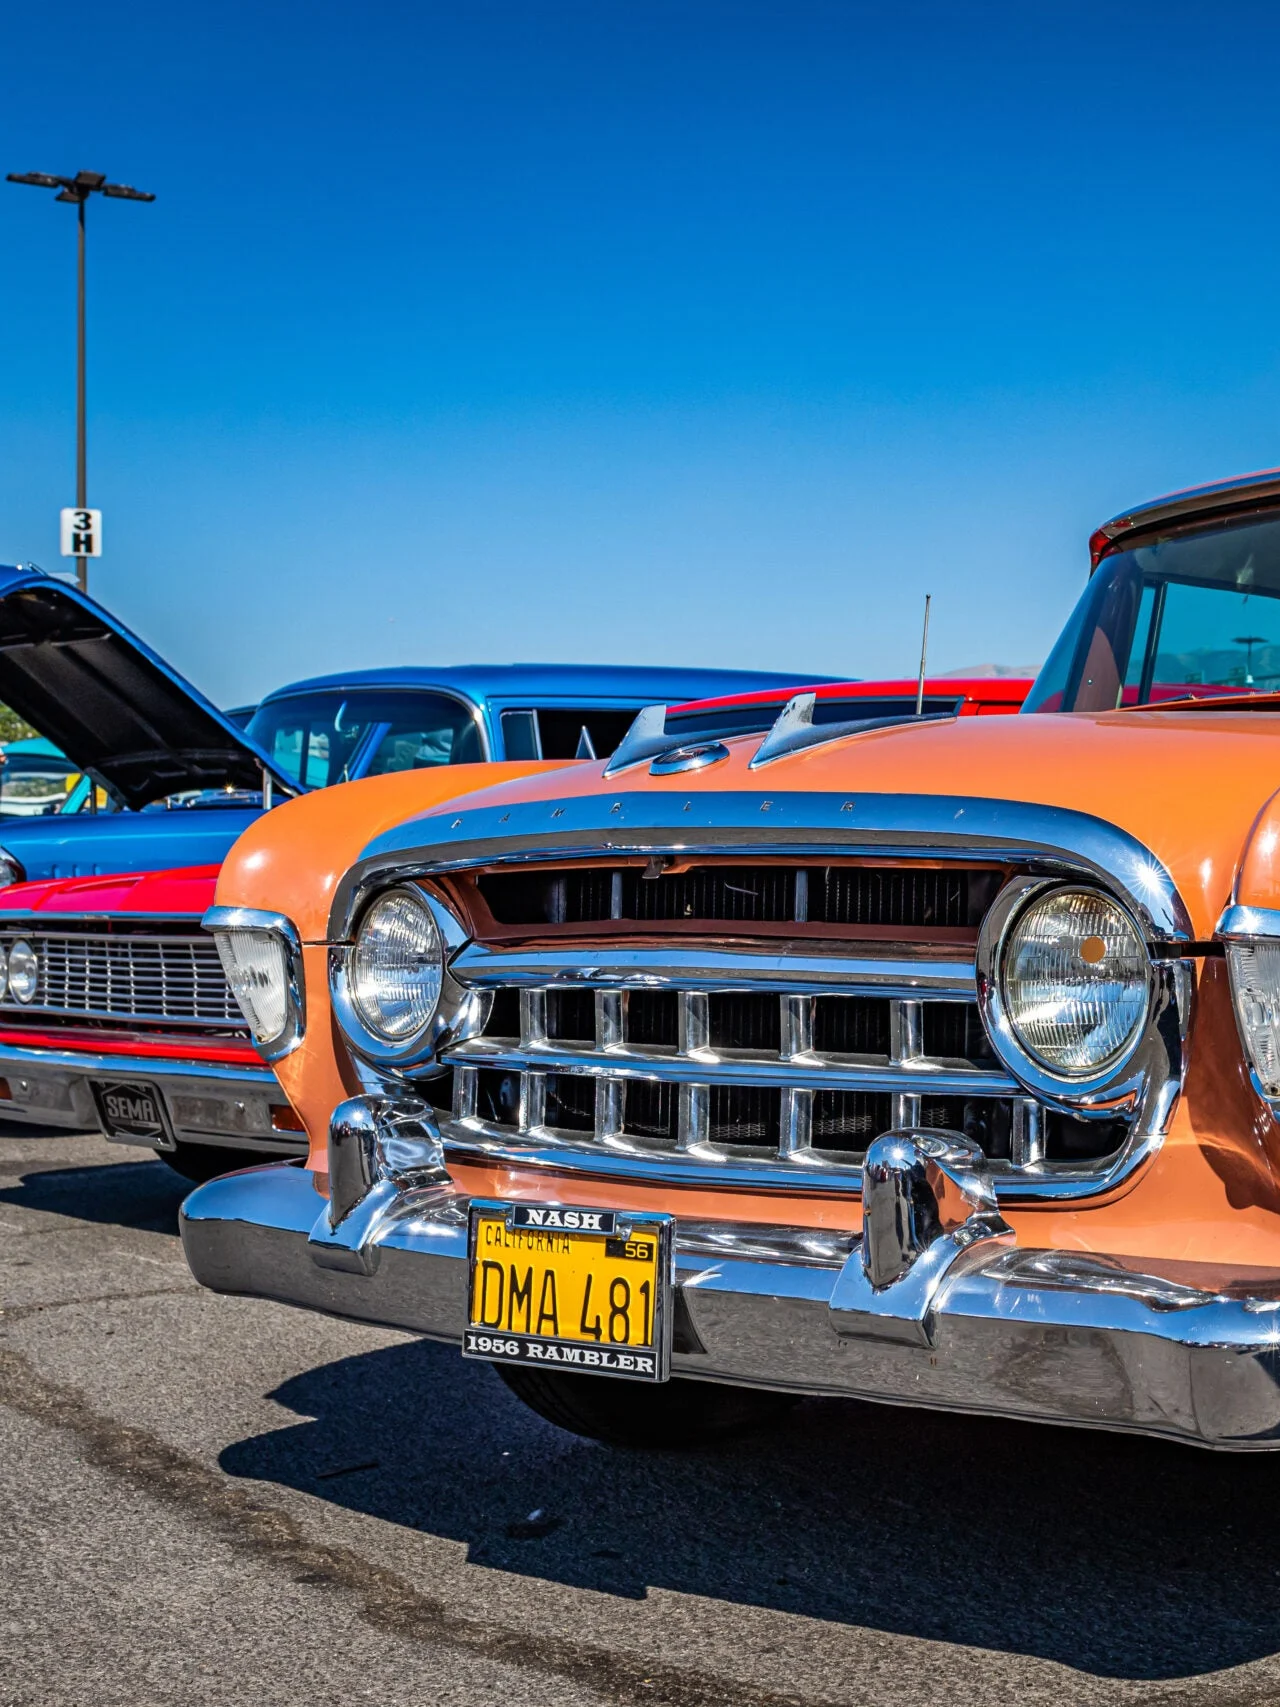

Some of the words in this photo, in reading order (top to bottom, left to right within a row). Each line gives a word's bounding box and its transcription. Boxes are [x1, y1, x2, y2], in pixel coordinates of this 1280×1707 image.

[106, 1096, 155, 1122] SEMA
[525, 1208, 602, 1230] NASH
[485, 1225, 570, 1254] CALIFORNIA
[625, 1242, 649, 1259] 56
[481, 1260, 559, 1337] DMA
[580, 1273, 651, 1346] 481
[466, 1335, 519, 1355] 1956
[526, 1342, 655, 1373] RAMBLER
